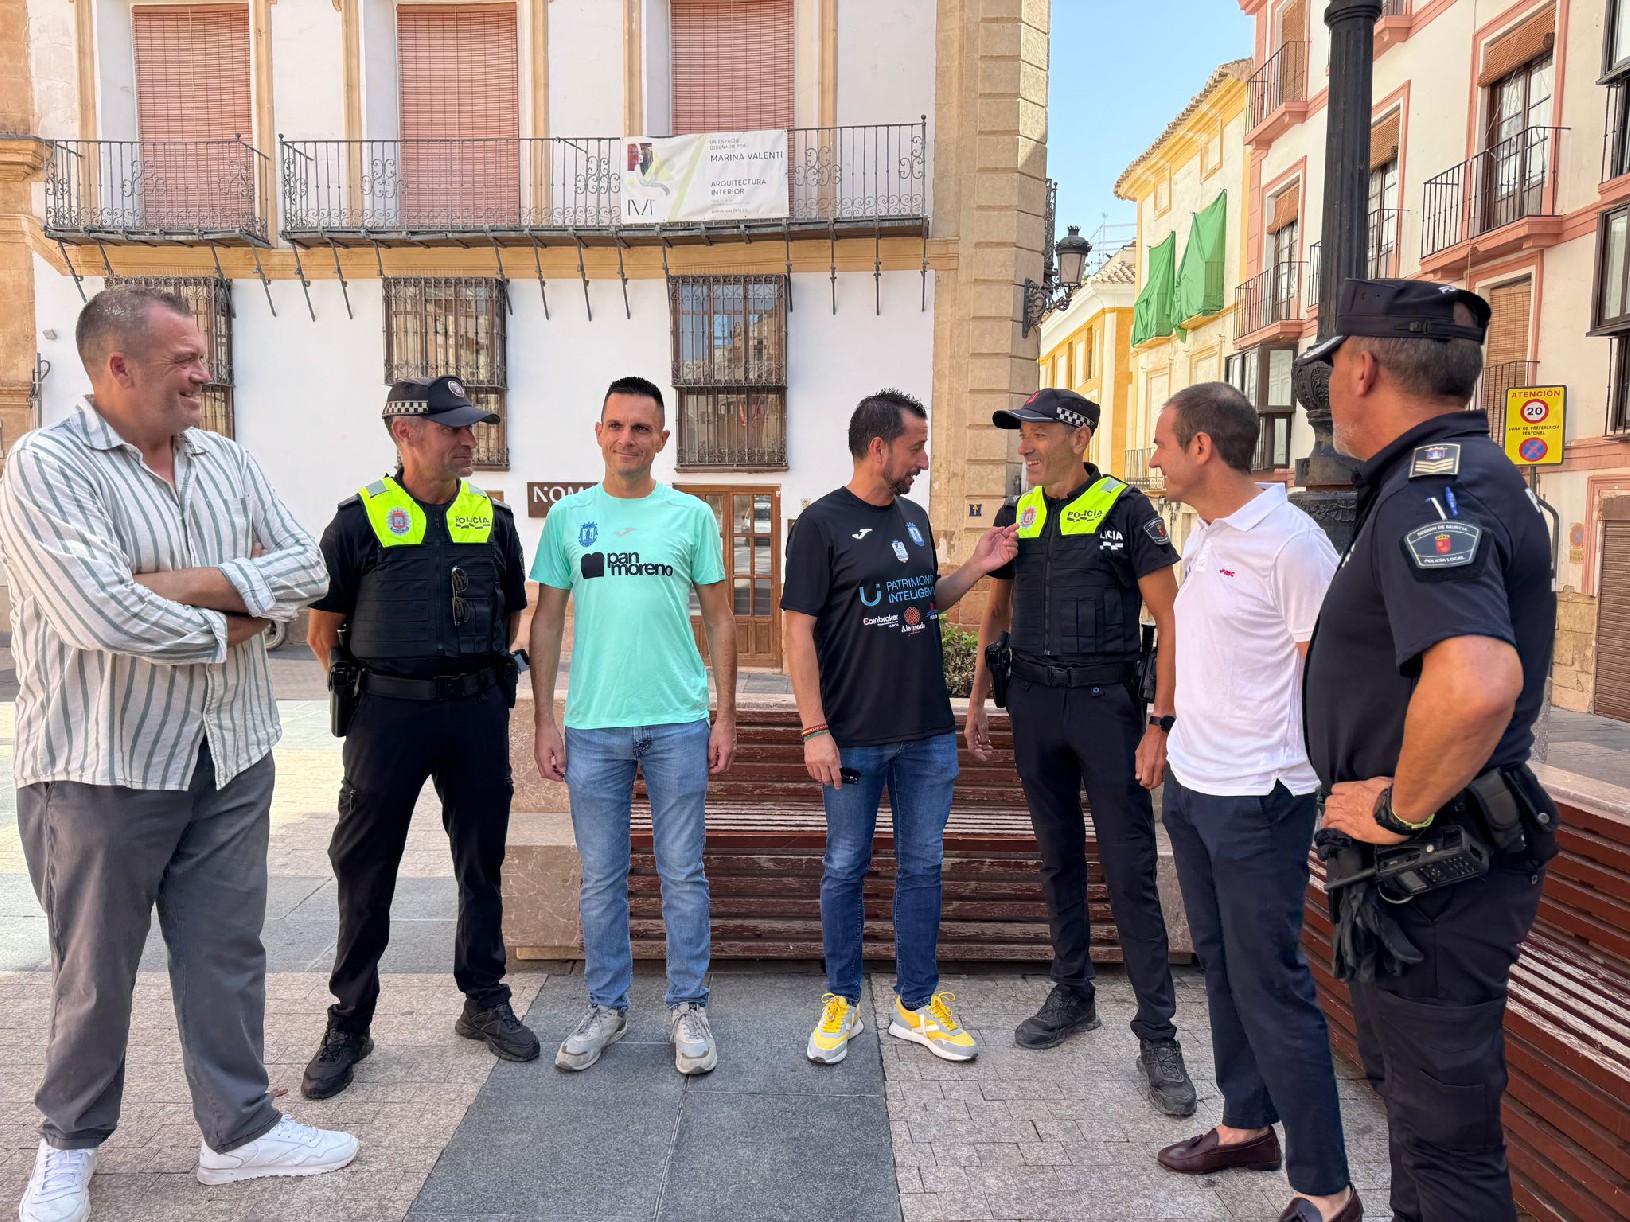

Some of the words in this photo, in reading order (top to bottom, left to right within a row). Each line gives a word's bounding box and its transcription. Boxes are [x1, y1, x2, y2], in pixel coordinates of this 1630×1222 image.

[710, 153, 745, 162] MARINA
[710, 178, 767, 187] ARQUITECTURA
[711, 188, 745, 196] INTERIOR
[1511, 389, 1560, 398] ATENCIÓN
[1527, 407, 1543, 416] 20
[607, 551, 640, 569] pan
[611, 563, 674, 577] moreno
